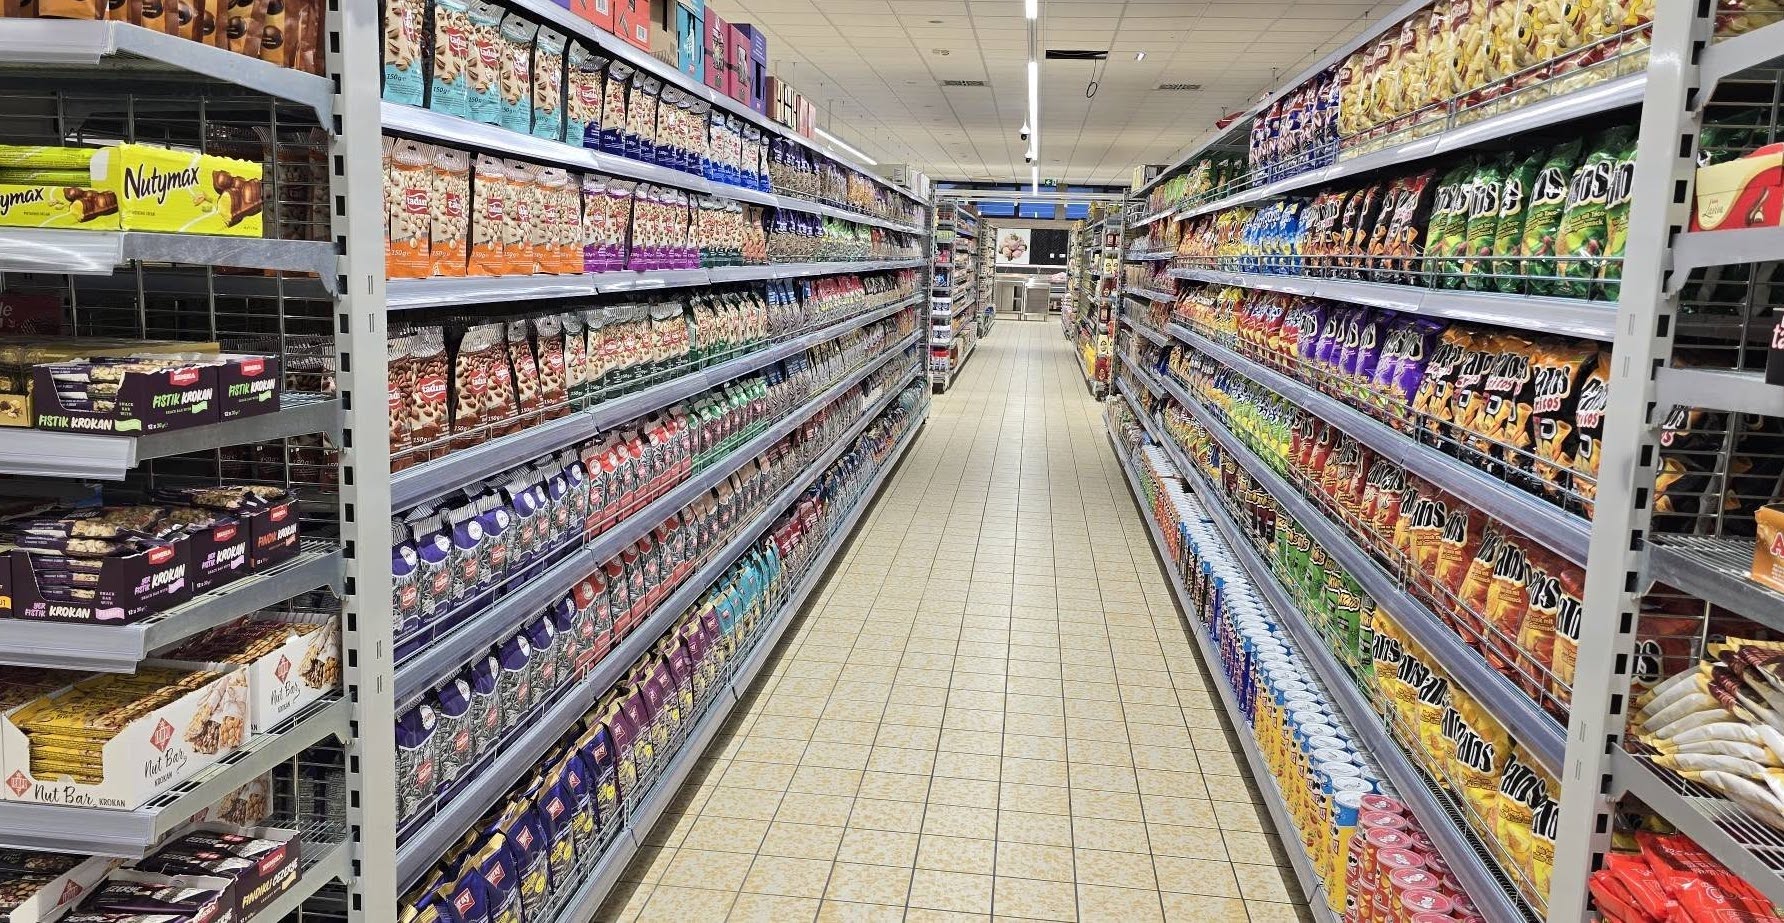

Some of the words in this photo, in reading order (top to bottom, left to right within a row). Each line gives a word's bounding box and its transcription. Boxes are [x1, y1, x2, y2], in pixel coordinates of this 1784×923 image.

[125, 164, 199, 205] Nutymax
[152, 394, 181, 409] FISTIK
[181, 388, 213, 403] KROKAN
[228, 383, 250, 398] FISTIK
[250, 378, 276, 393] KROKAN
[38, 414, 69, 428] FISTIK
[71, 417, 113, 431] KROKAN
[216, 542, 246, 564] KROKAN
[151, 563, 186, 588] KROKAN
[49, 606, 91, 619] KROKAN
[144, 755, 163, 778] Nut
[164, 747, 187, 770] Bar
[154, 771, 173, 787] KROKAN
[34, 784, 60, 802] Nut
[63, 785, 97, 807] Bar
[100, 799, 126, 808] KROKAN
